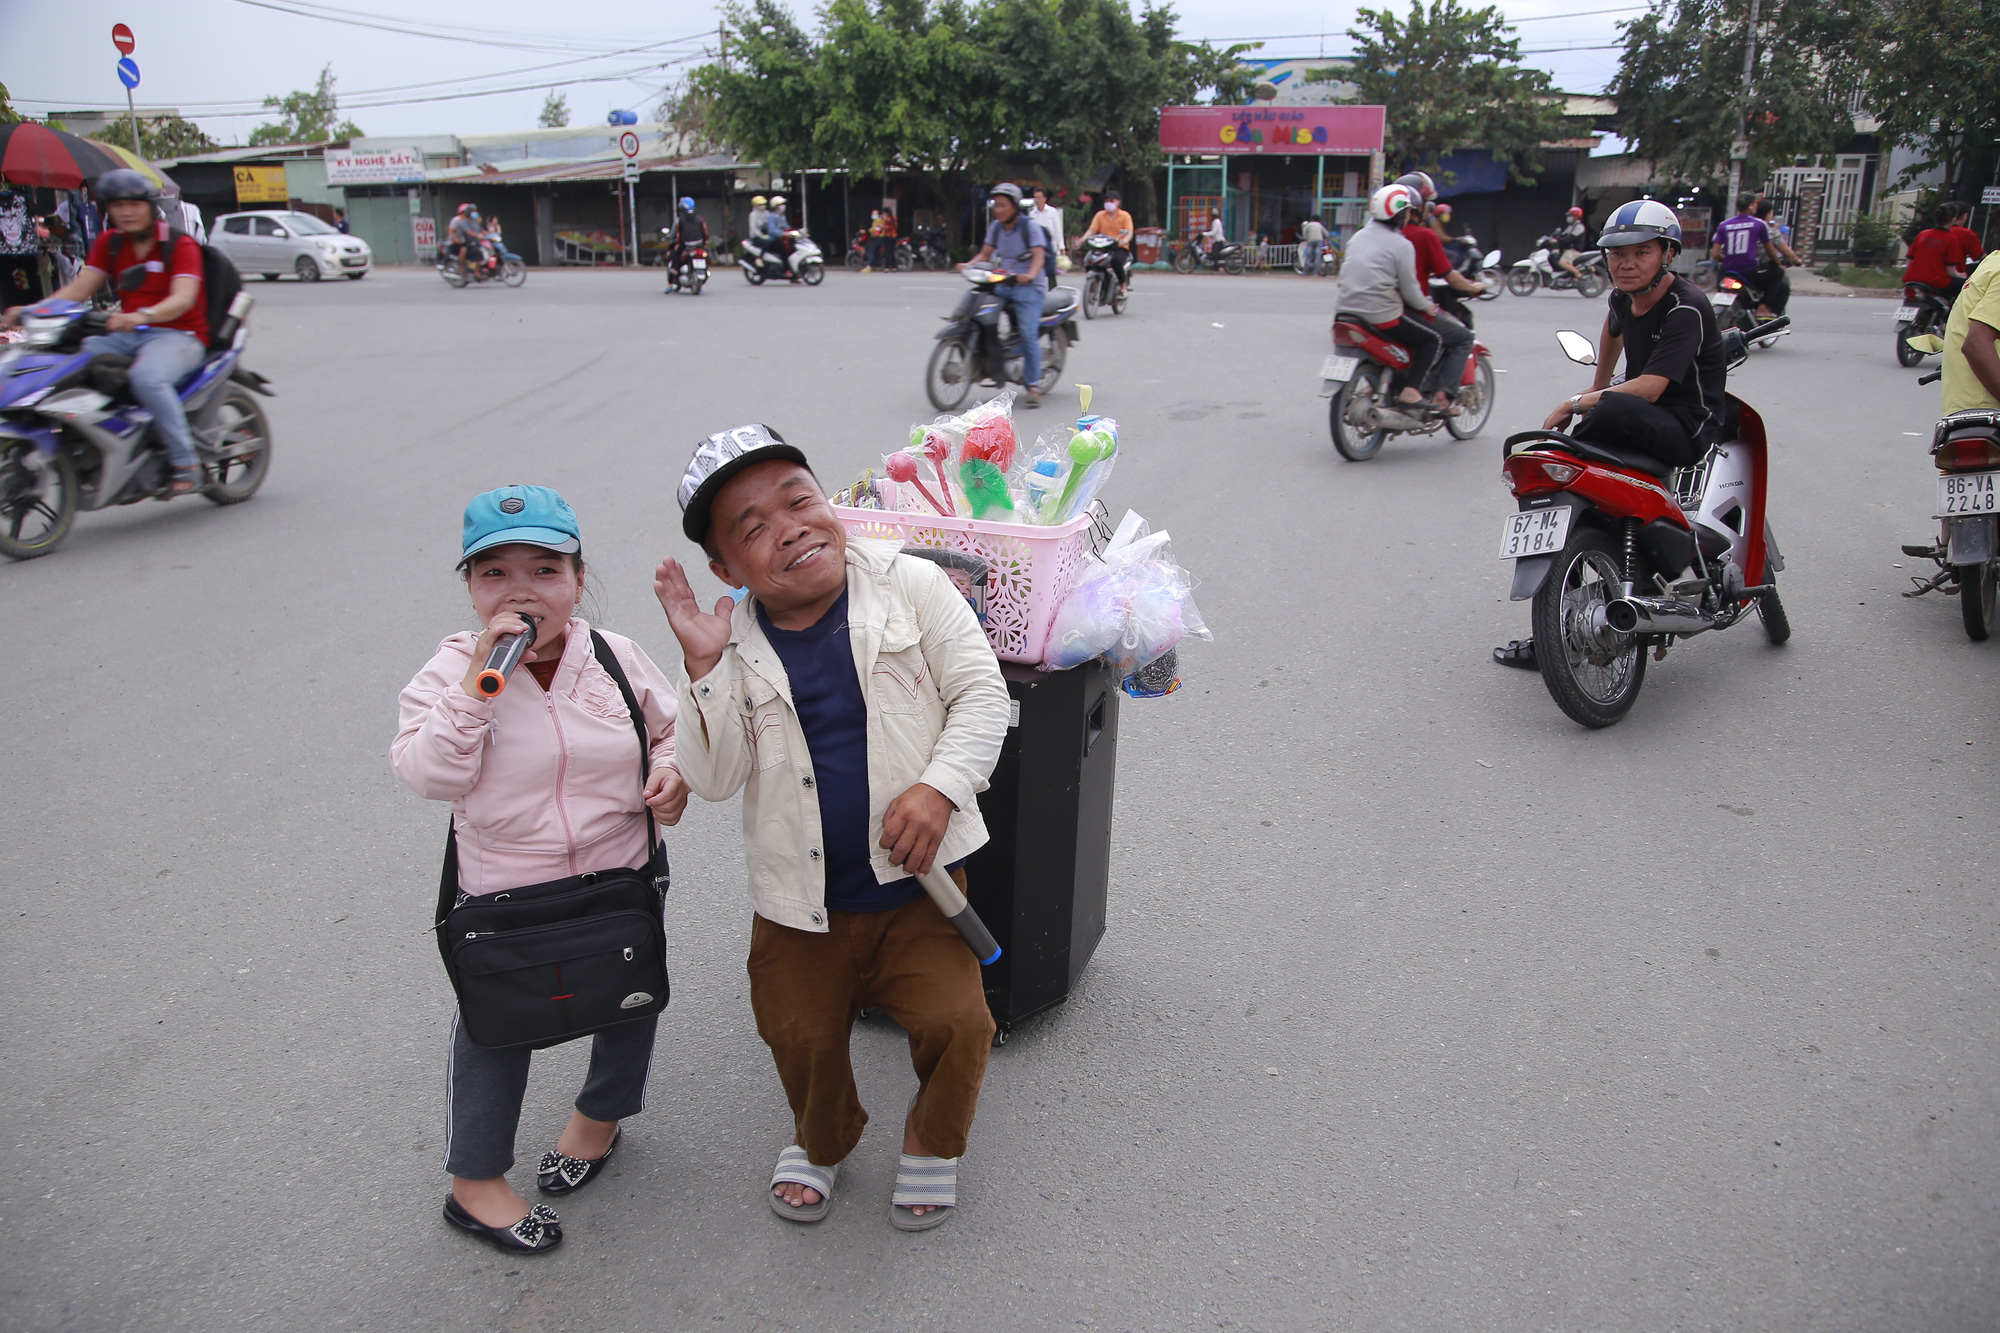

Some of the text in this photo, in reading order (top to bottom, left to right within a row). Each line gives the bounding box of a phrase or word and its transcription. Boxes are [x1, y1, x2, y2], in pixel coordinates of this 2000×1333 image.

[1727, 229, 1750, 255] 10
[1718, 480, 1745, 489] HONDA
[1947, 475, 1993, 495] 86-VA
[1947, 493, 1994, 513] 2248
[1513, 510, 1558, 534] 67-M4
[1509, 531, 1554, 554] 3184
